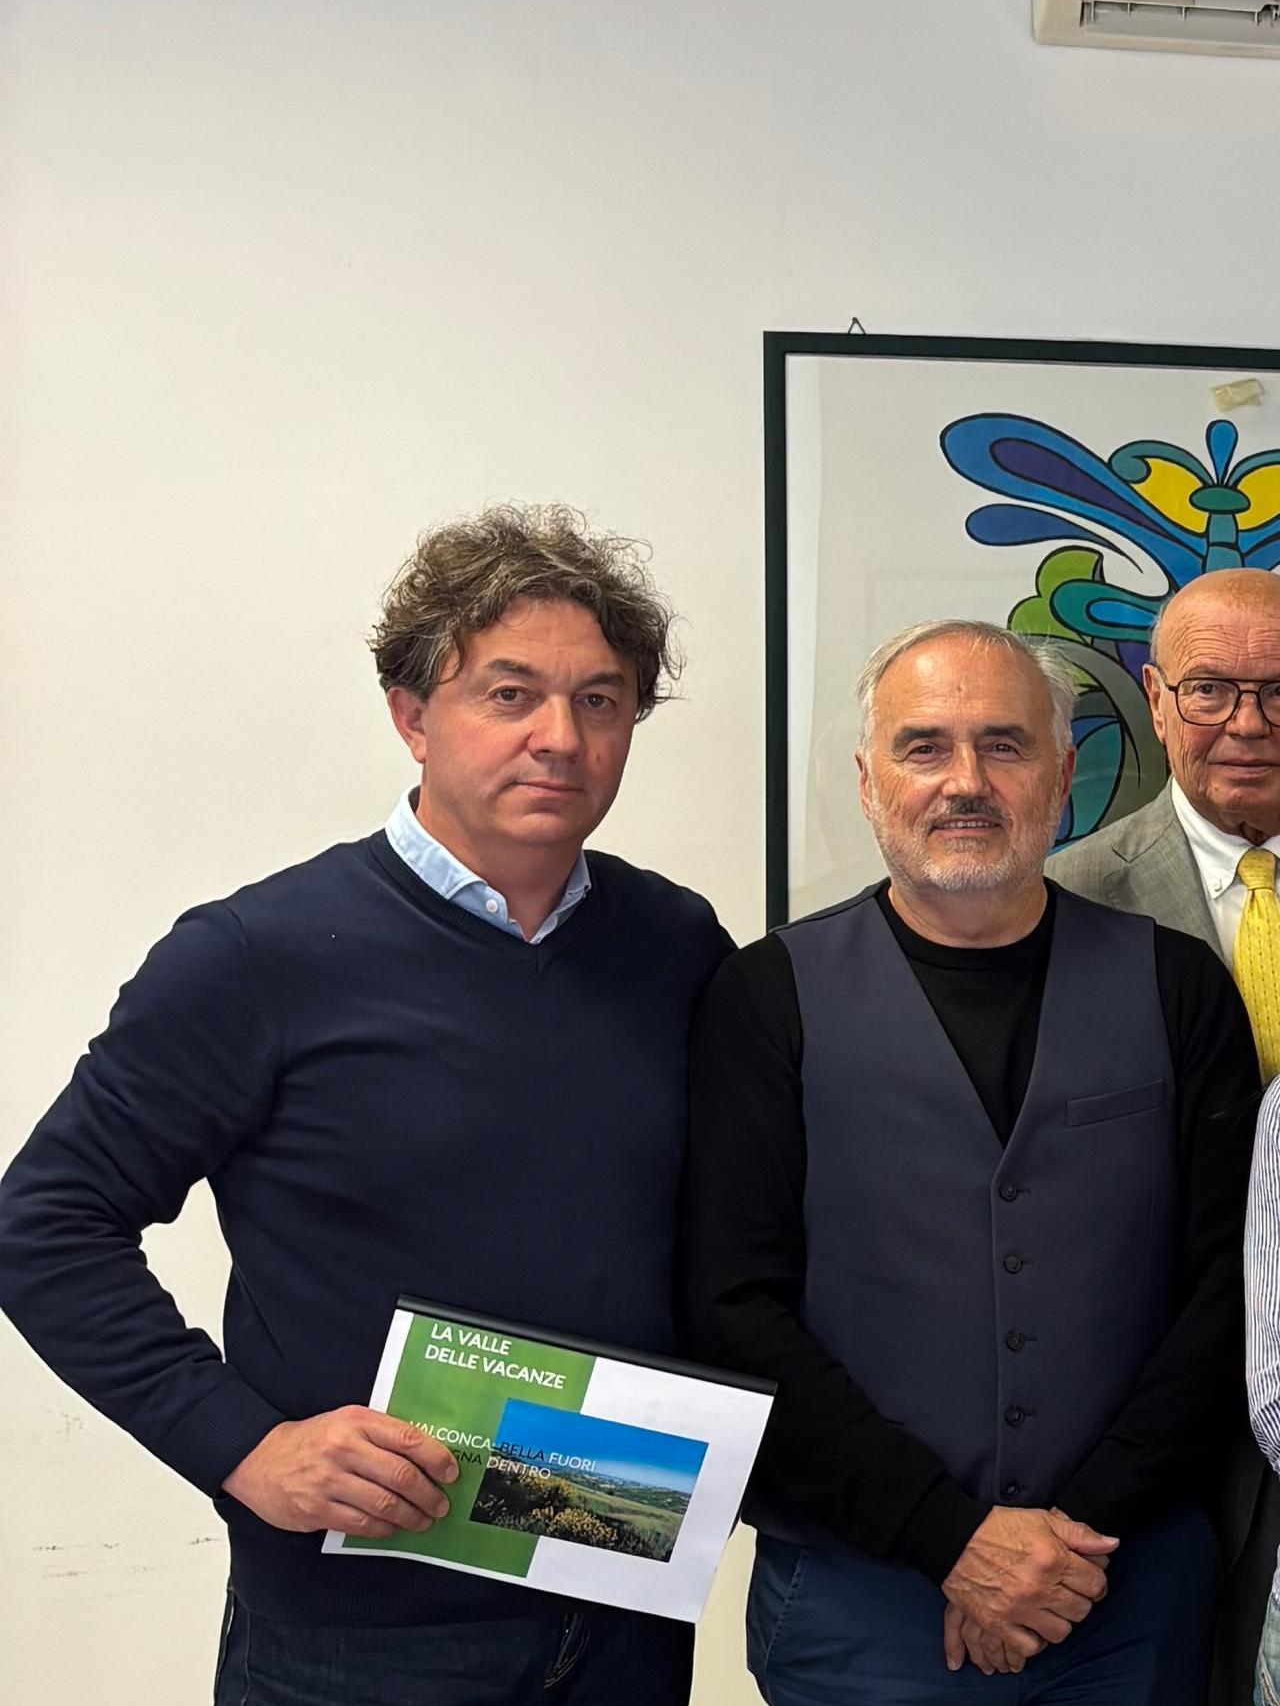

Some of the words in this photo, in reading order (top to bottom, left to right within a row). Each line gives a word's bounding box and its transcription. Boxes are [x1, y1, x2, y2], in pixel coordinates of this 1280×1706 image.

[431, 1323, 452, 1342] LA
[459, 1330, 512, 1355] VALLE
[425, 1344, 479, 1370] DELLE
[483, 1356, 567, 1389] VACANZE
[486, 1456, 551, 1480] DENTRO
[499, 1441, 545, 1462] BELLA
[548, 1452, 597, 1473] FUORI
